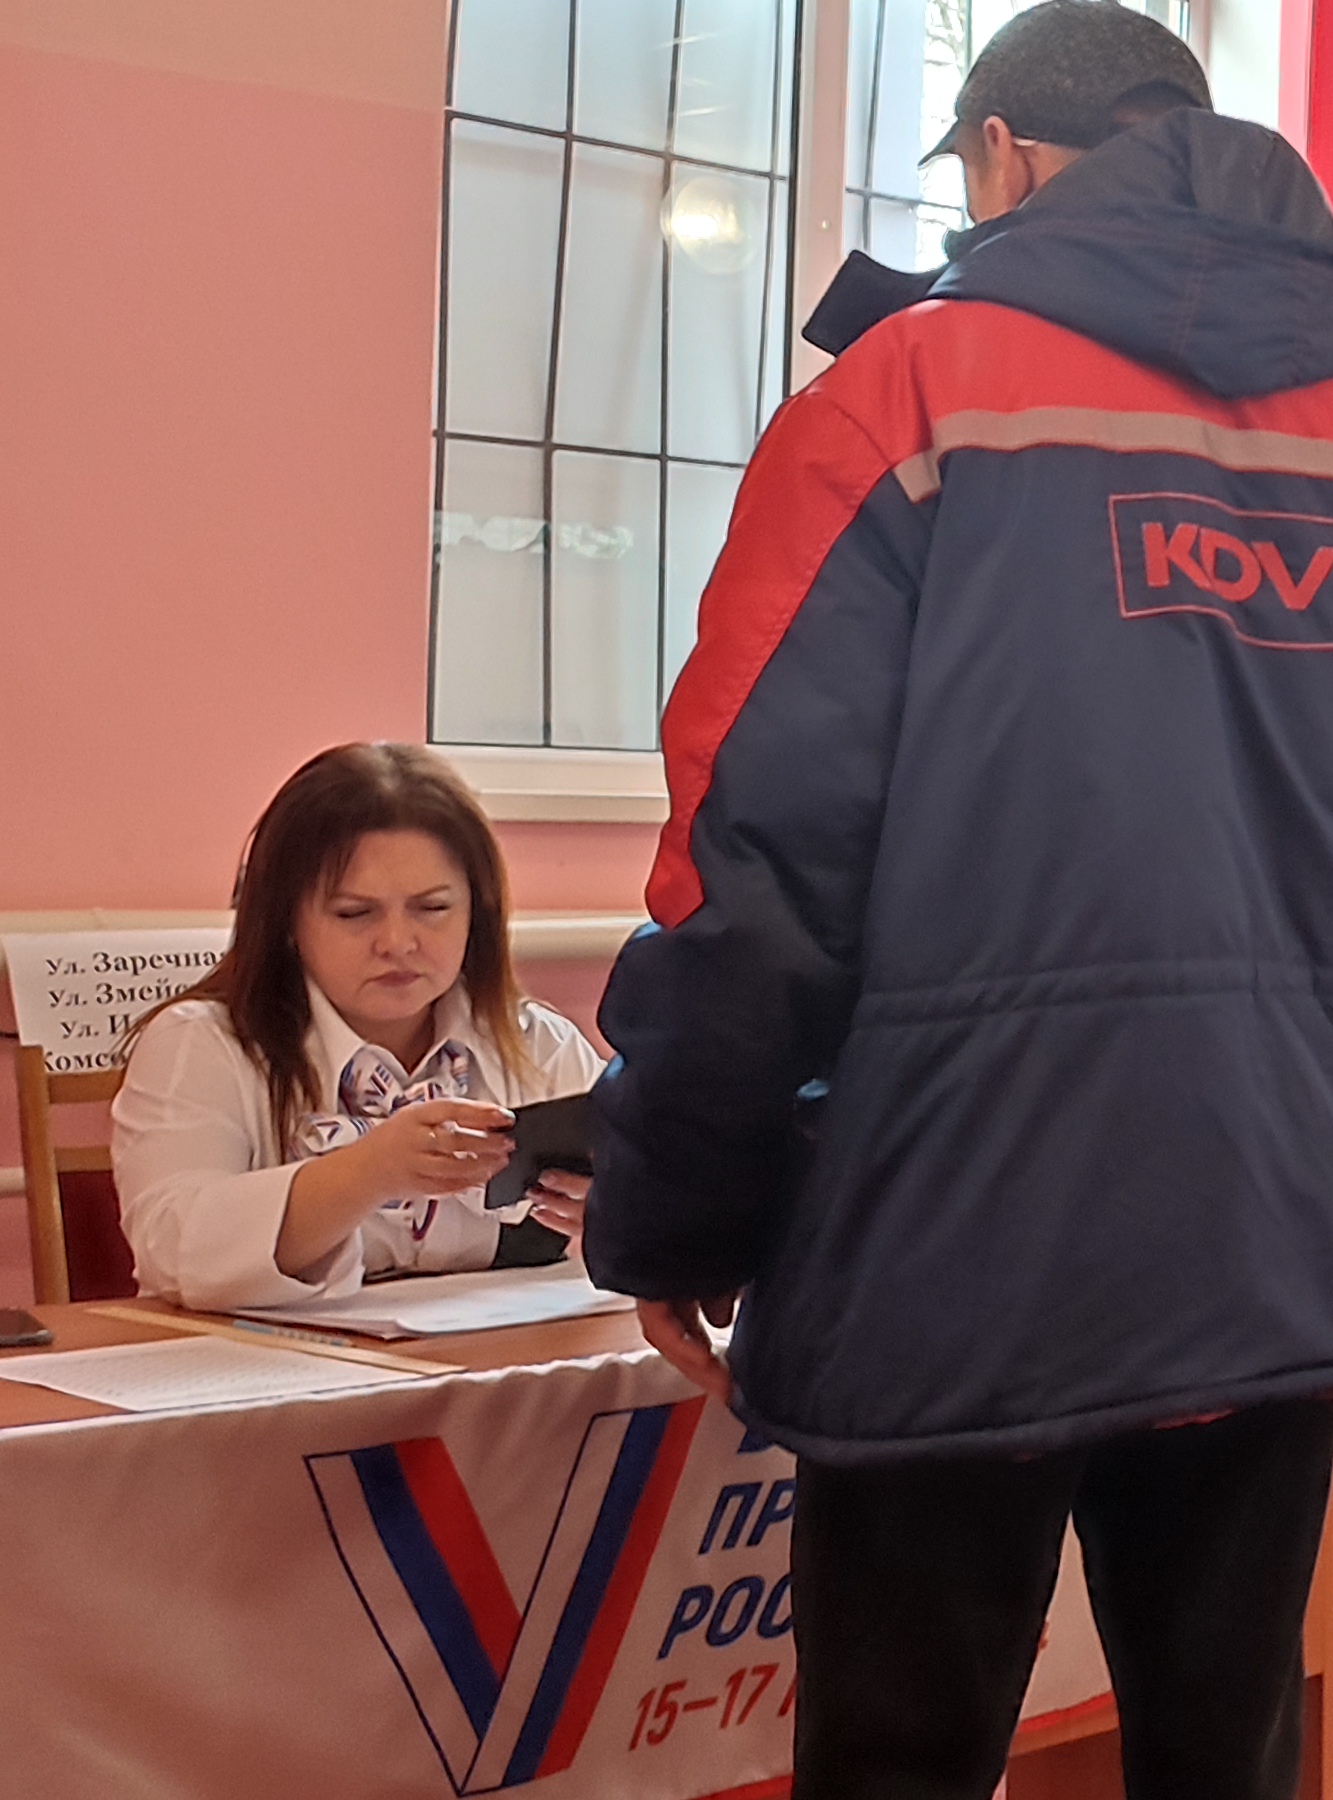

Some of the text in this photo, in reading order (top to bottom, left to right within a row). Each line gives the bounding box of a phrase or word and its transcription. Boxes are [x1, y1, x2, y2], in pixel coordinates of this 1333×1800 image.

[46, 957, 85, 976] Ул.
[48, 977, 190, 1008] Ул. Змейс
[60, 1020, 99, 1039] Ул.
[656, 1573, 793, 1661] РОС
